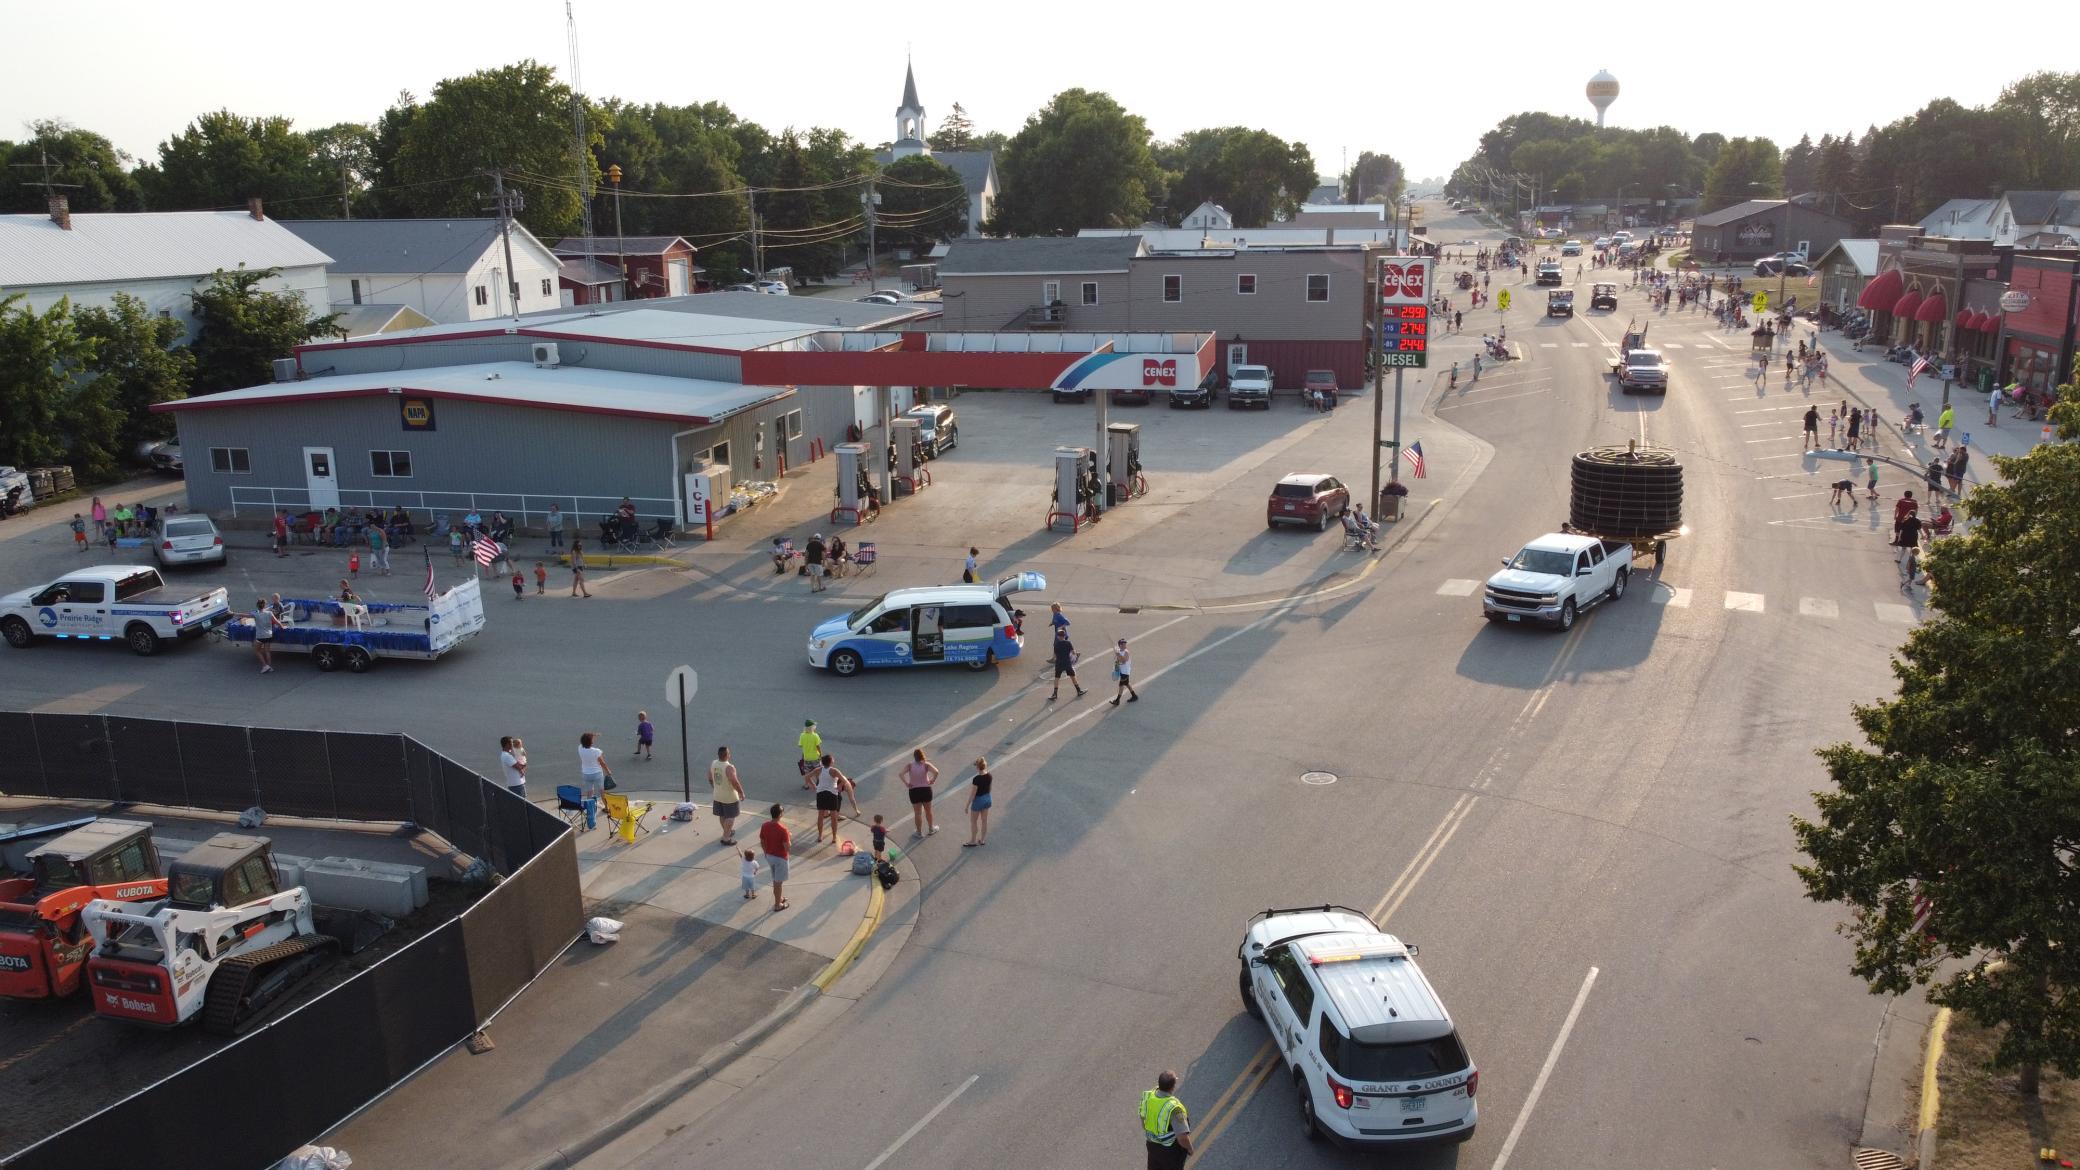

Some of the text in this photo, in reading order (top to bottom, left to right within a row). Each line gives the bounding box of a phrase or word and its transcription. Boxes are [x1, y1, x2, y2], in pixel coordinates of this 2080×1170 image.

[1384, 275, 1422, 286] CENEX
[1382, 353, 1419, 366] DIESEL
[1144, 367, 1175, 377] CENEX
[406, 406, 426, 419] NAPA
[692, 478, 703, 515] ICE
[60, 614, 103, 624] Prairie Ridge
[116, 886, 153, 898] KUBOTA
[122, 997, 157, 1013] Bobcat
[1361, 1075, 1463, 1093] GRANT COUNTY
